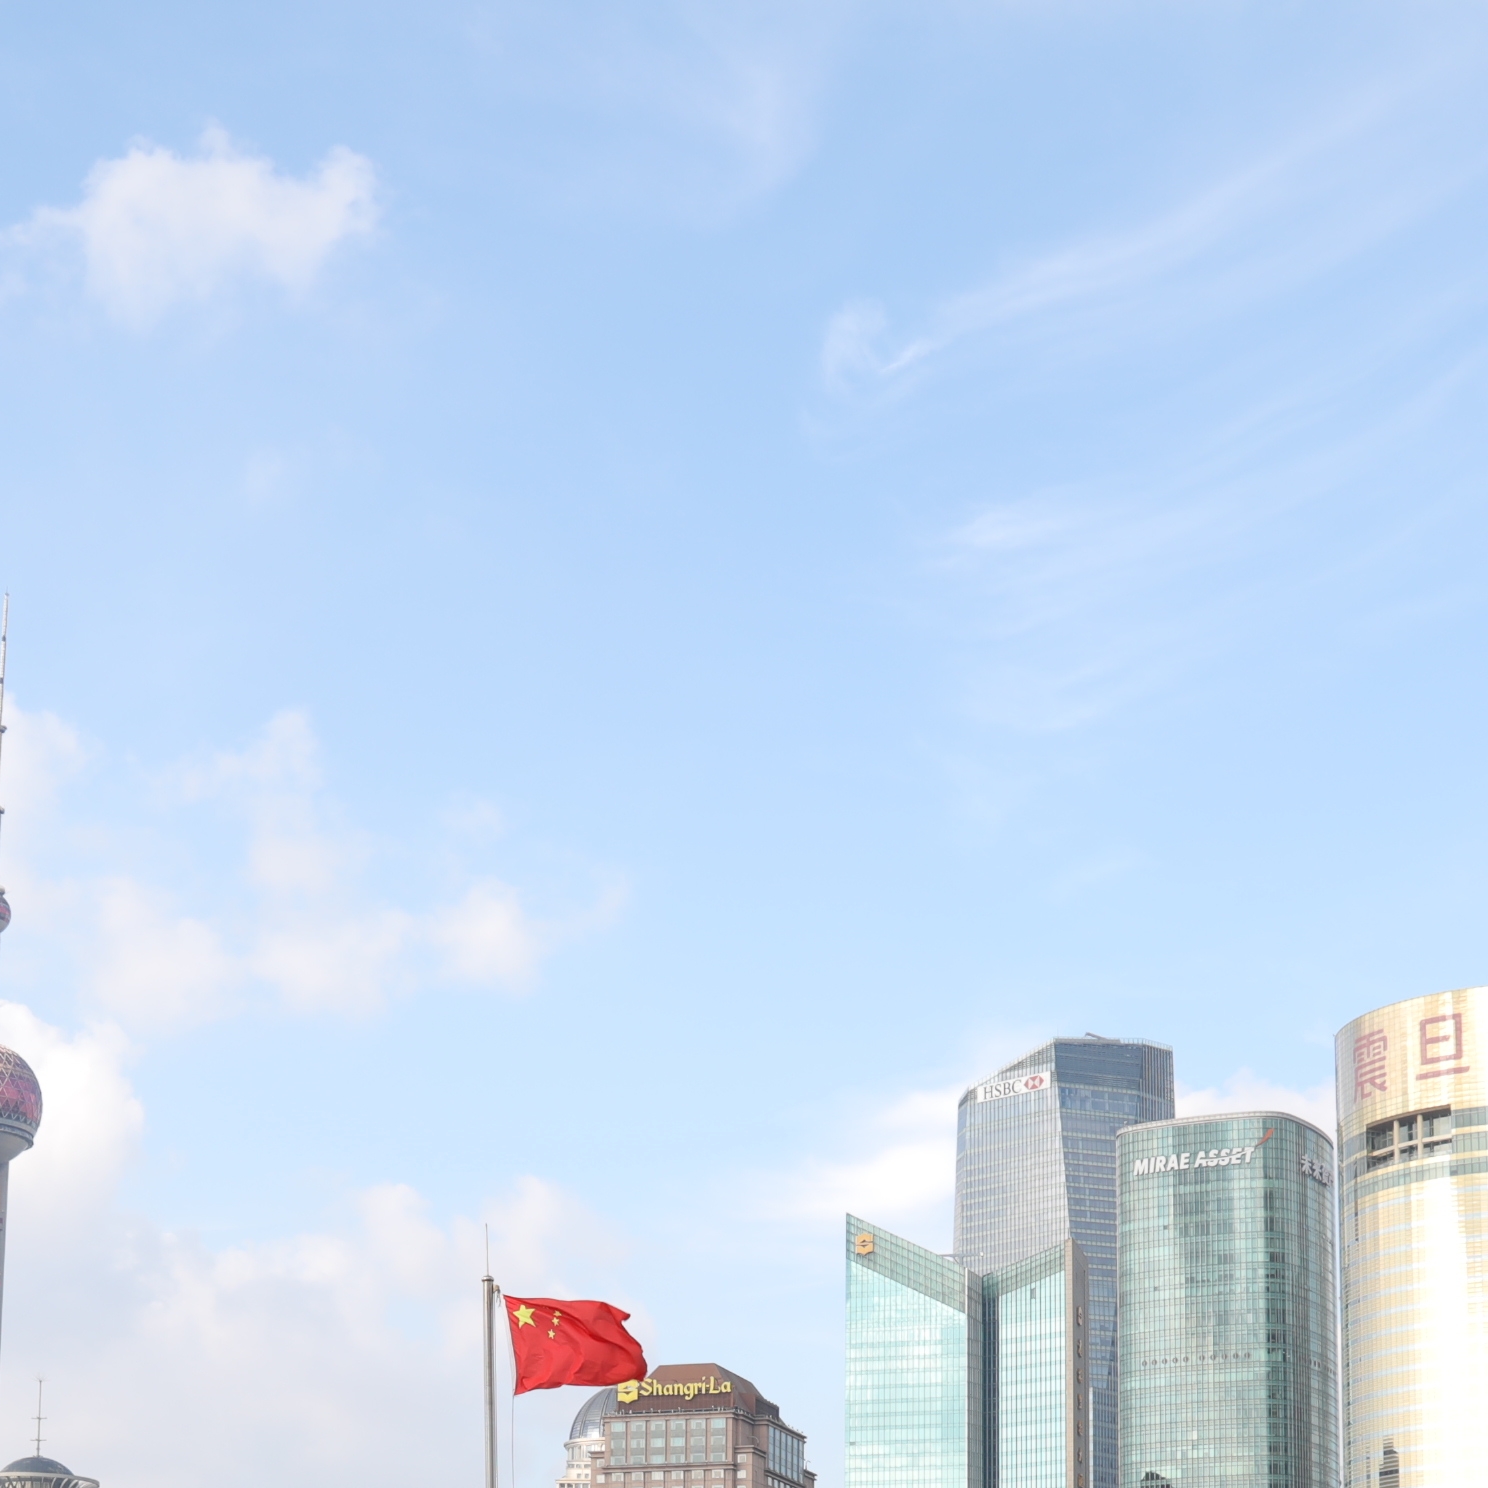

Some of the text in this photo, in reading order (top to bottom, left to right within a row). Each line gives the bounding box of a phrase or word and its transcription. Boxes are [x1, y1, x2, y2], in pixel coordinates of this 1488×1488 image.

[1353, 1012, 1471, 1104] 震旦
[983, 1078, 1022, 1100] HSBC
[1133, 1147, 1256, 1176] MIRAE ASSET
[639, 1376, 732, 1400] Shangri-La
